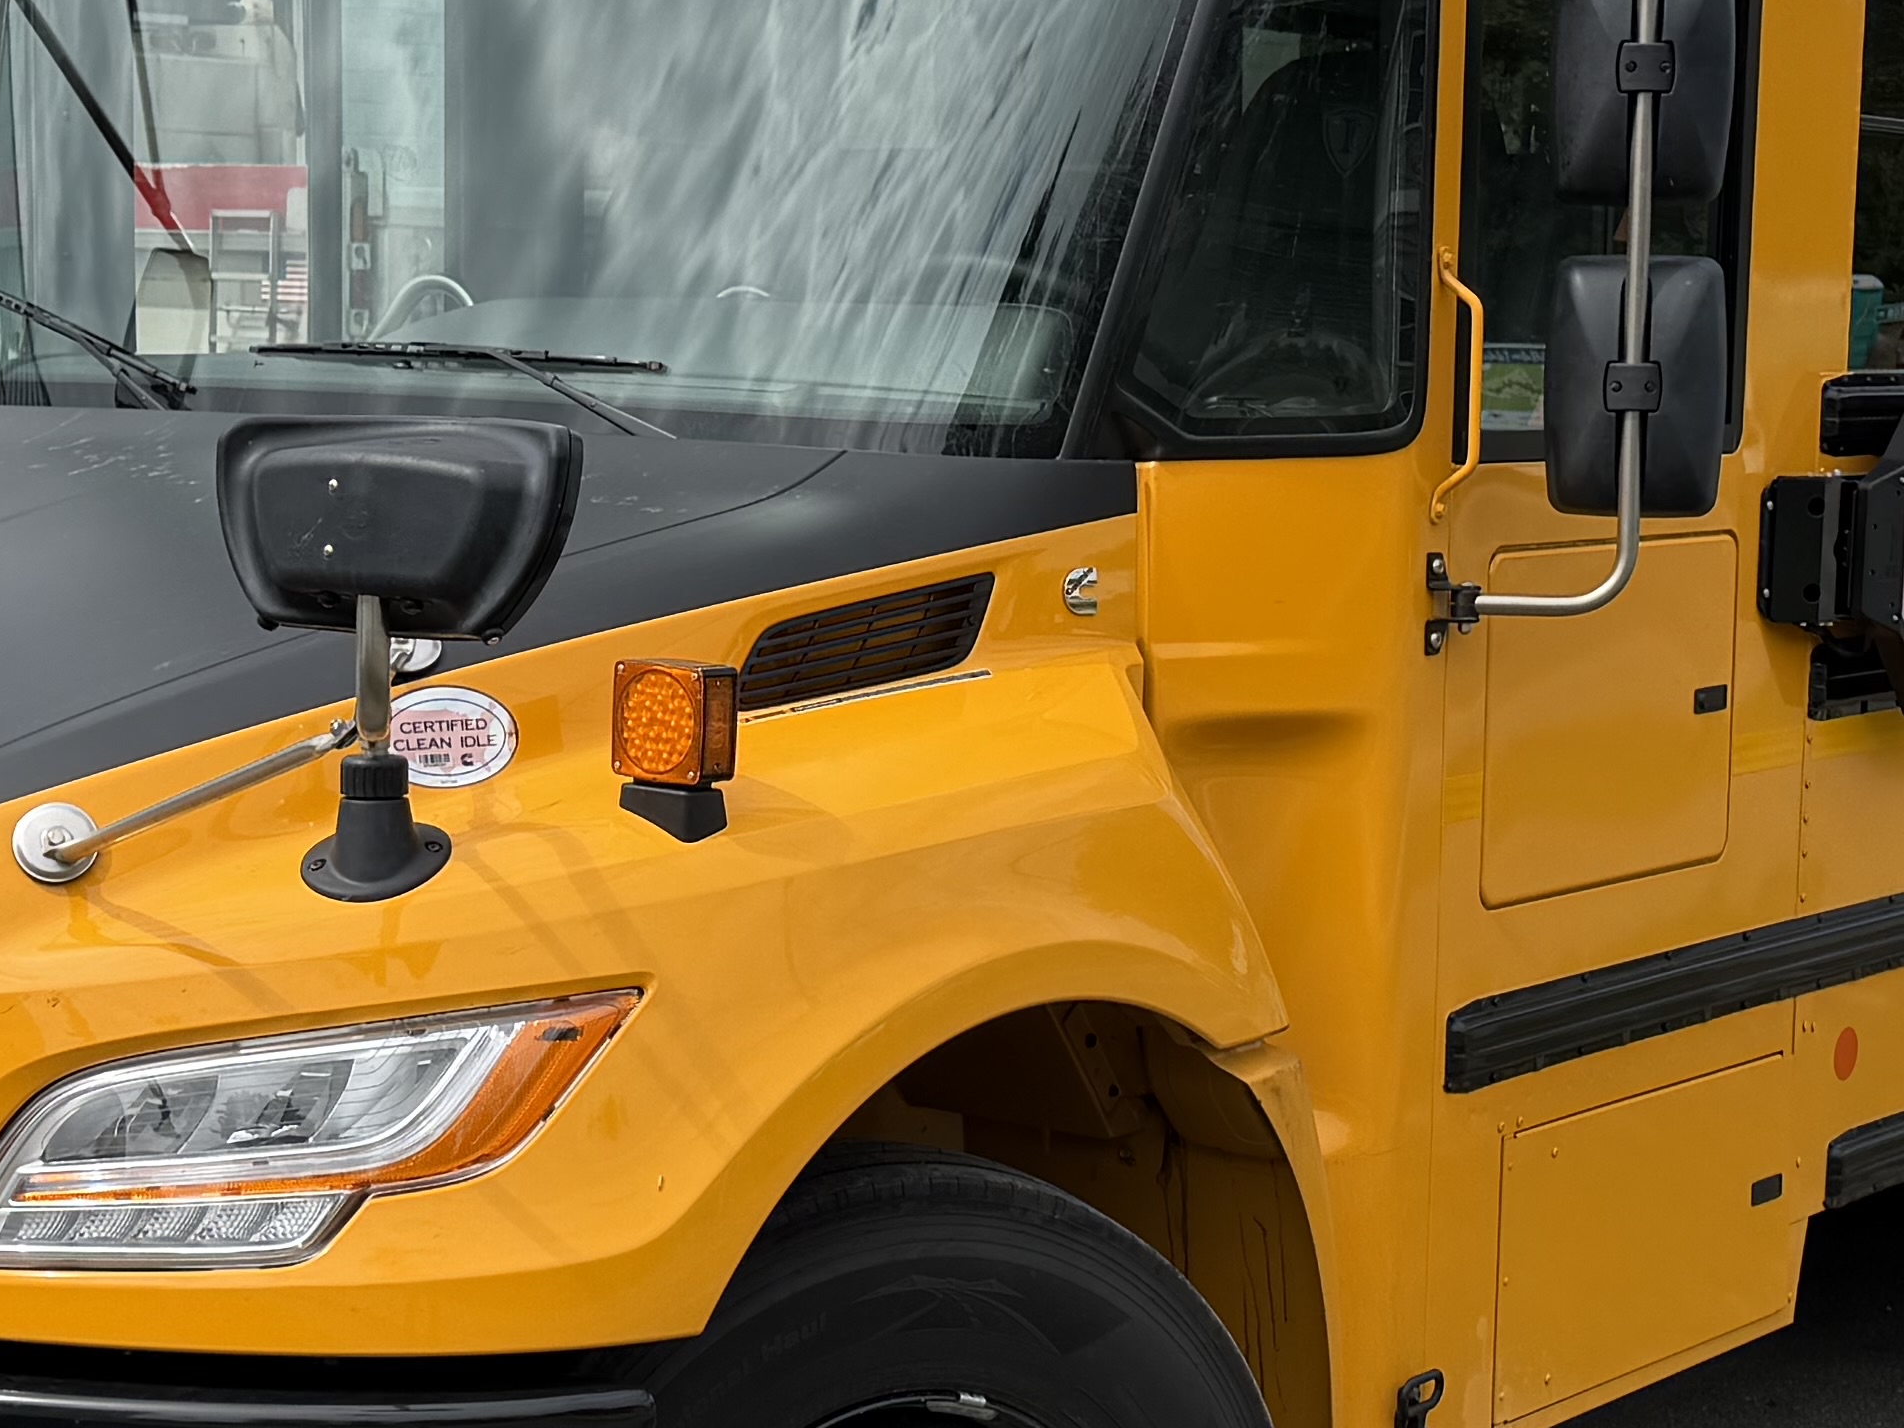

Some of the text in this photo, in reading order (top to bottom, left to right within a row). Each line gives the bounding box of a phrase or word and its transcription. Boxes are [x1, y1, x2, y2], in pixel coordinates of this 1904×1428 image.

[399, 718, 488, 735] CERTIFIED
[393, 734, 498, 752] CLEAN IDLE
